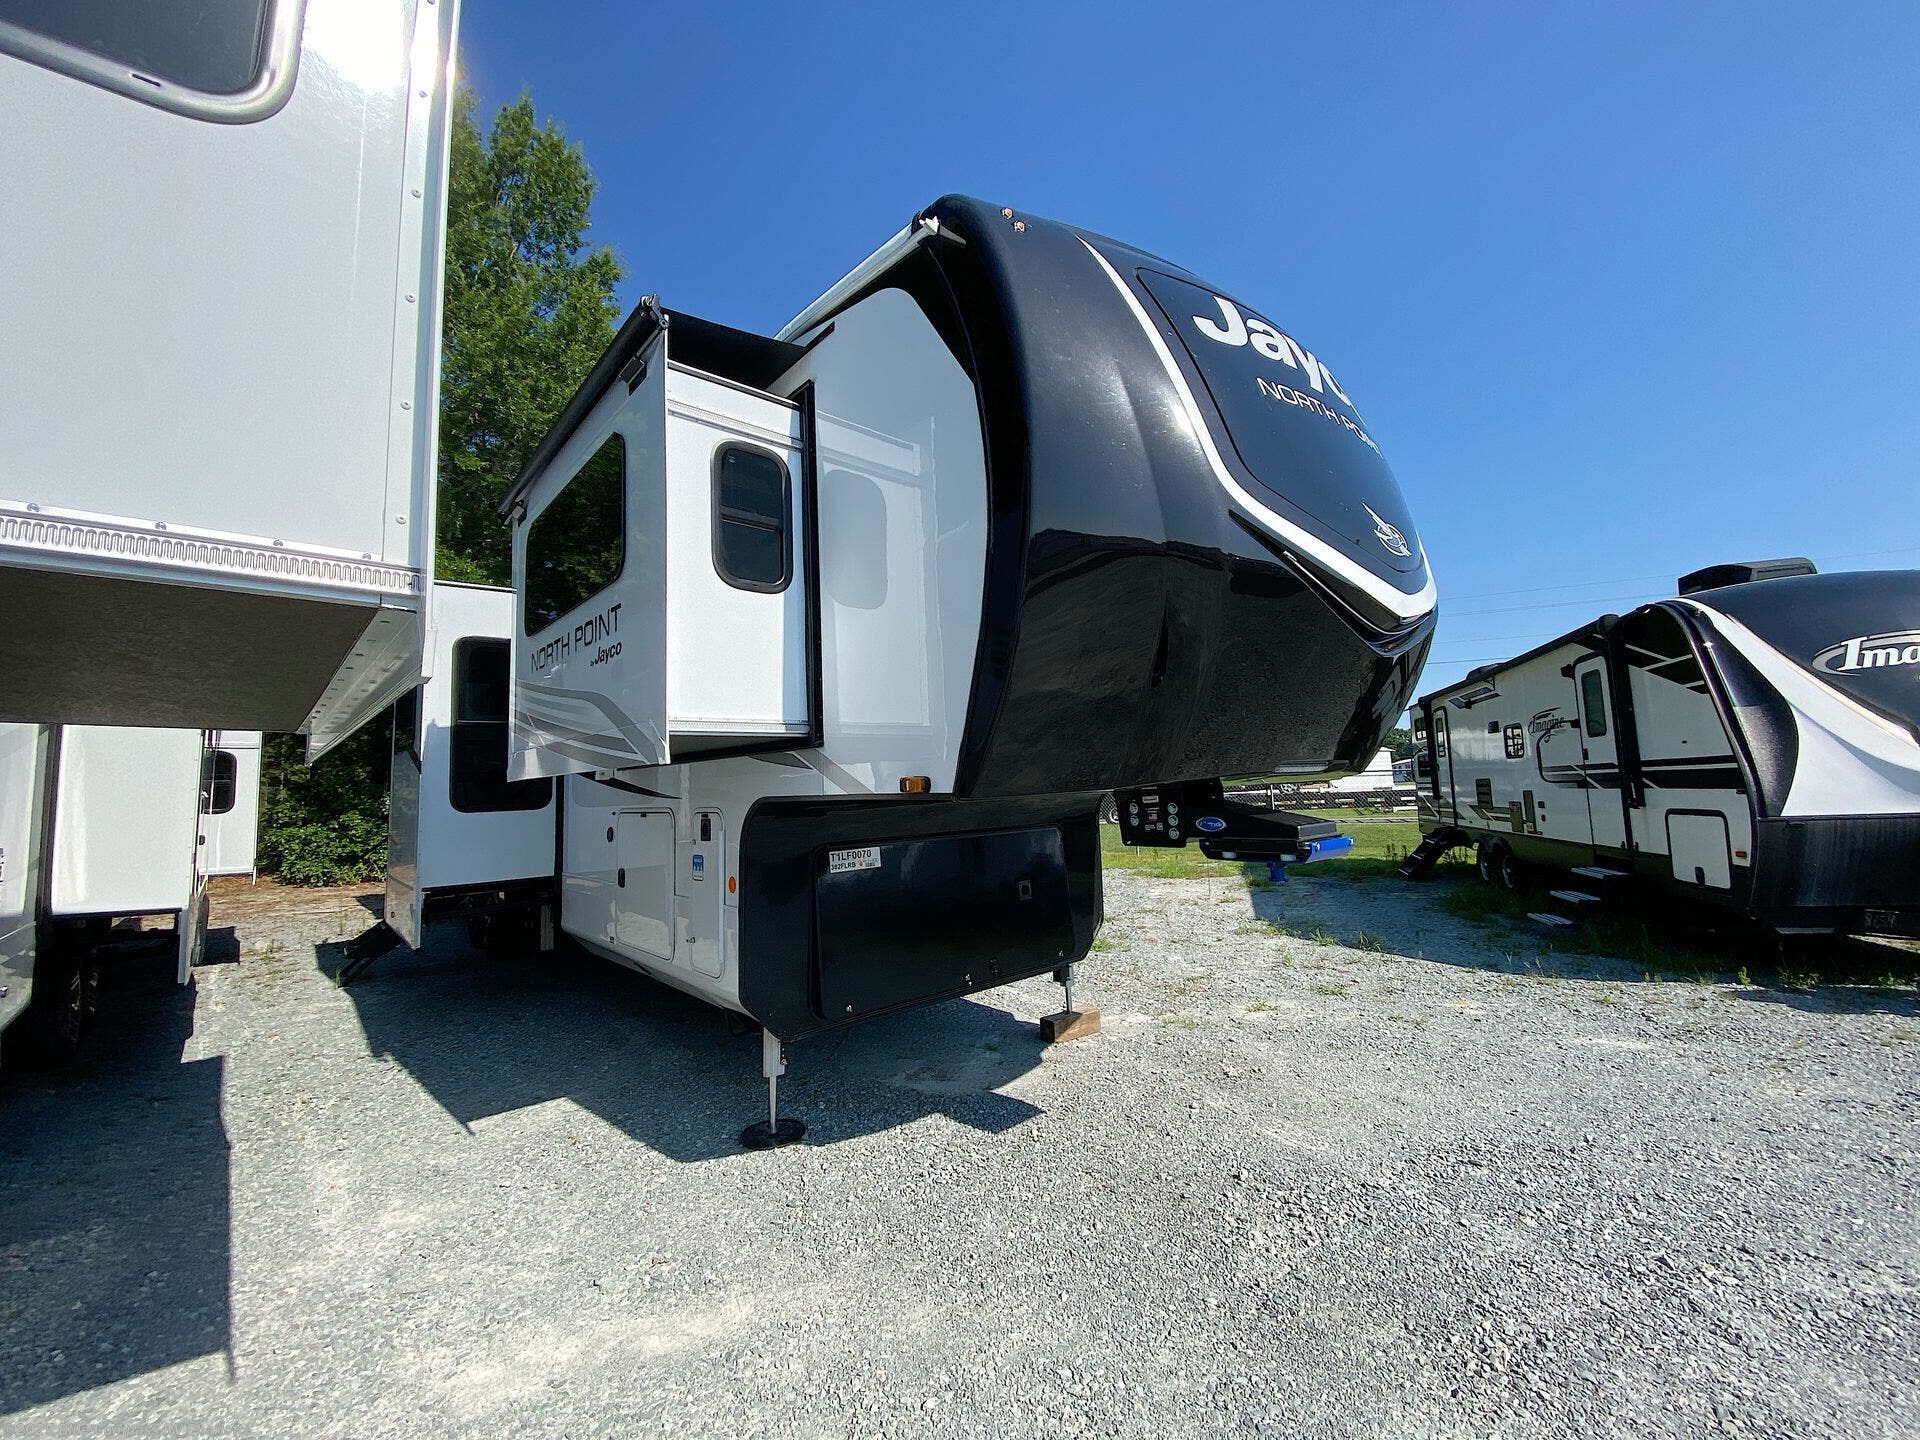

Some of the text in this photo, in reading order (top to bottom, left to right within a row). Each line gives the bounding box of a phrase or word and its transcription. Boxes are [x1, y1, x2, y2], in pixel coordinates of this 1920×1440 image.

[1256, 377, 1341, 425] NORTH
[531, 603, 622, 673] NORTH POINT
[595, 641, 622, 665] Jayco
[830, 849, 872, 862] T1LF0070
